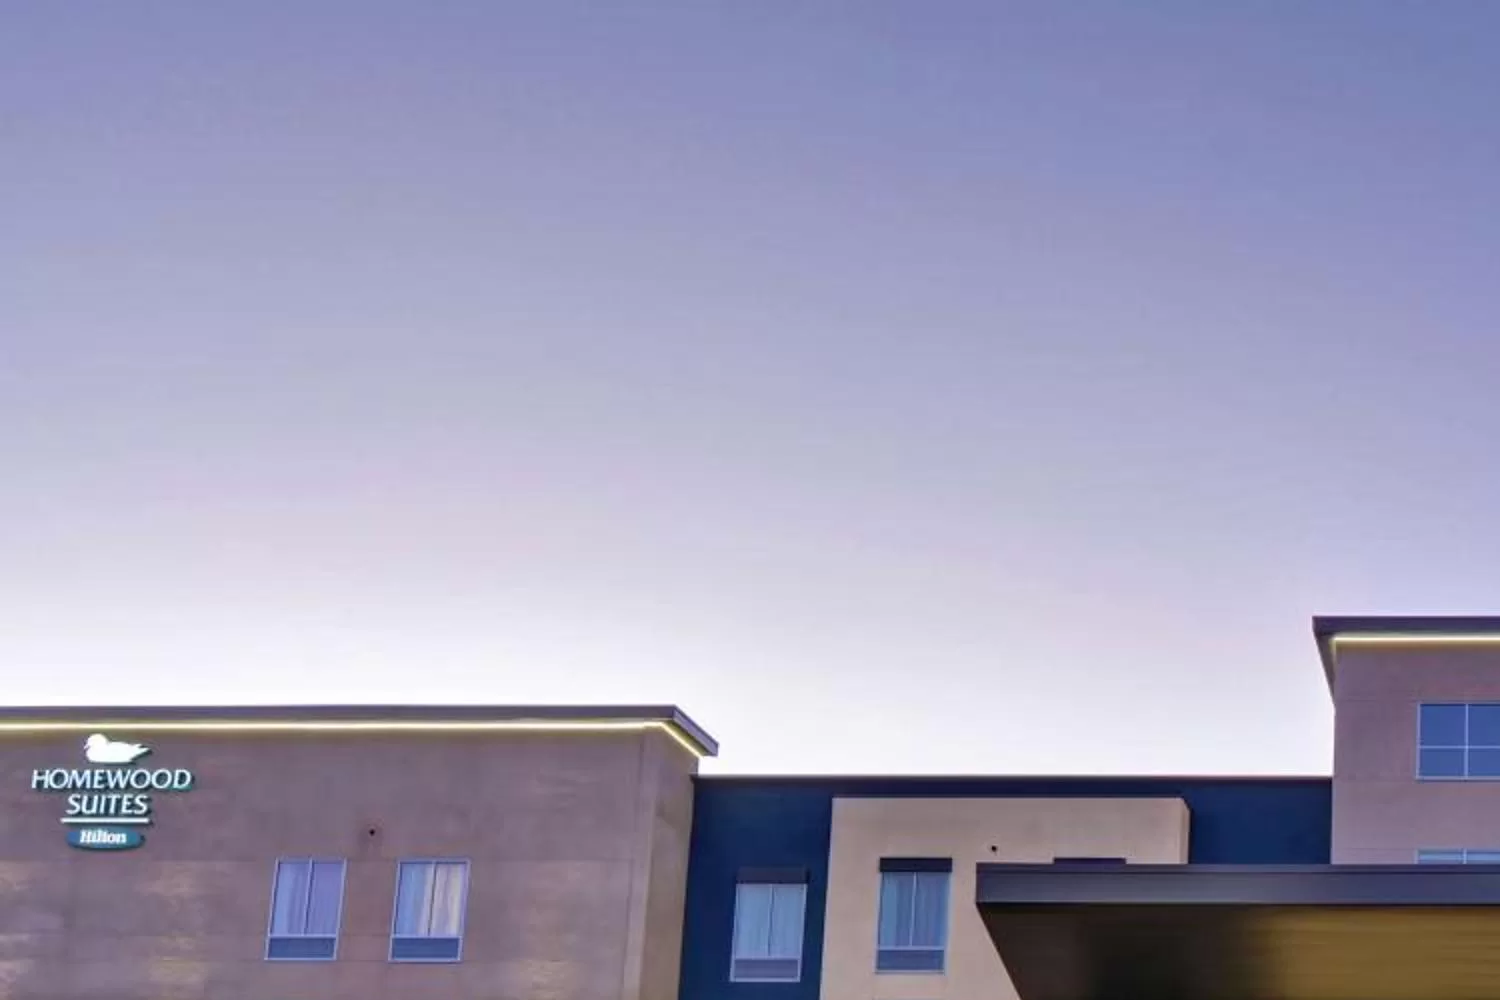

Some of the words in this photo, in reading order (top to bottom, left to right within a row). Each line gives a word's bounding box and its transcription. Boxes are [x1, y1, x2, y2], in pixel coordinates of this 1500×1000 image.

[31, 768, 193, 790] HOMEWOOD
[65, 793, 149, 815] SUITES
[79, 828, 128, 845] Hilton
